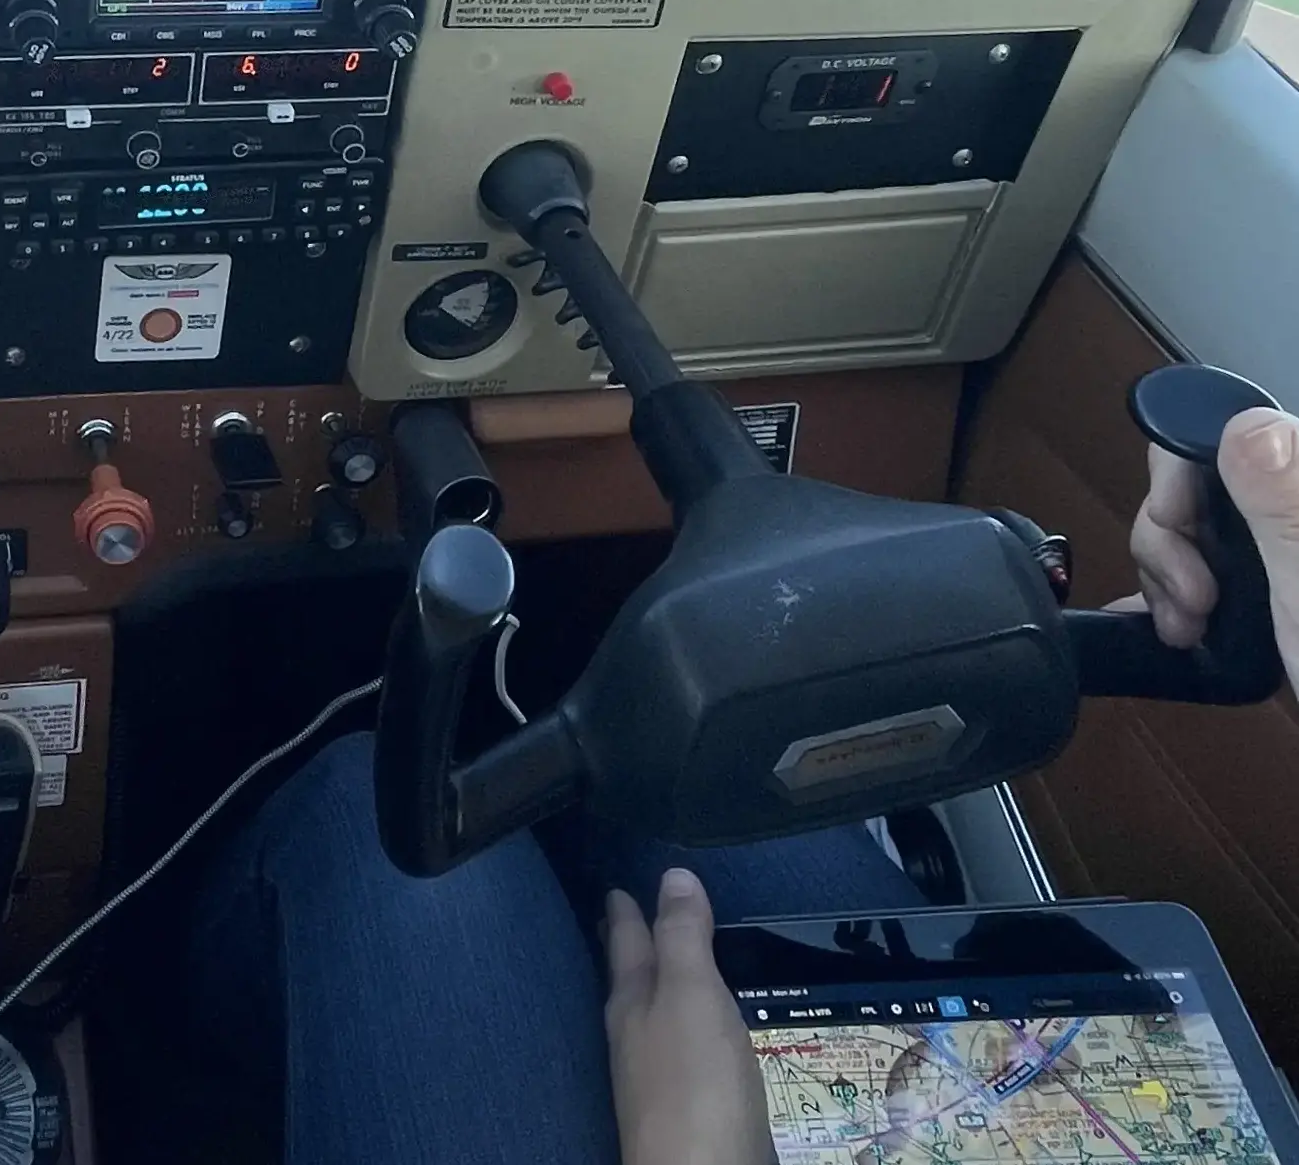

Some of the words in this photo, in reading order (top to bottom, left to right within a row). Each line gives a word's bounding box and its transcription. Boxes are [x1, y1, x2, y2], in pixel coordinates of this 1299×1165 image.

[151, 58, 168, 77] 2
[345, 52, 360, 72] 0
[846, 57, 897, 68] VOLTAGE
[302, 181, 324, 189] FUNC
